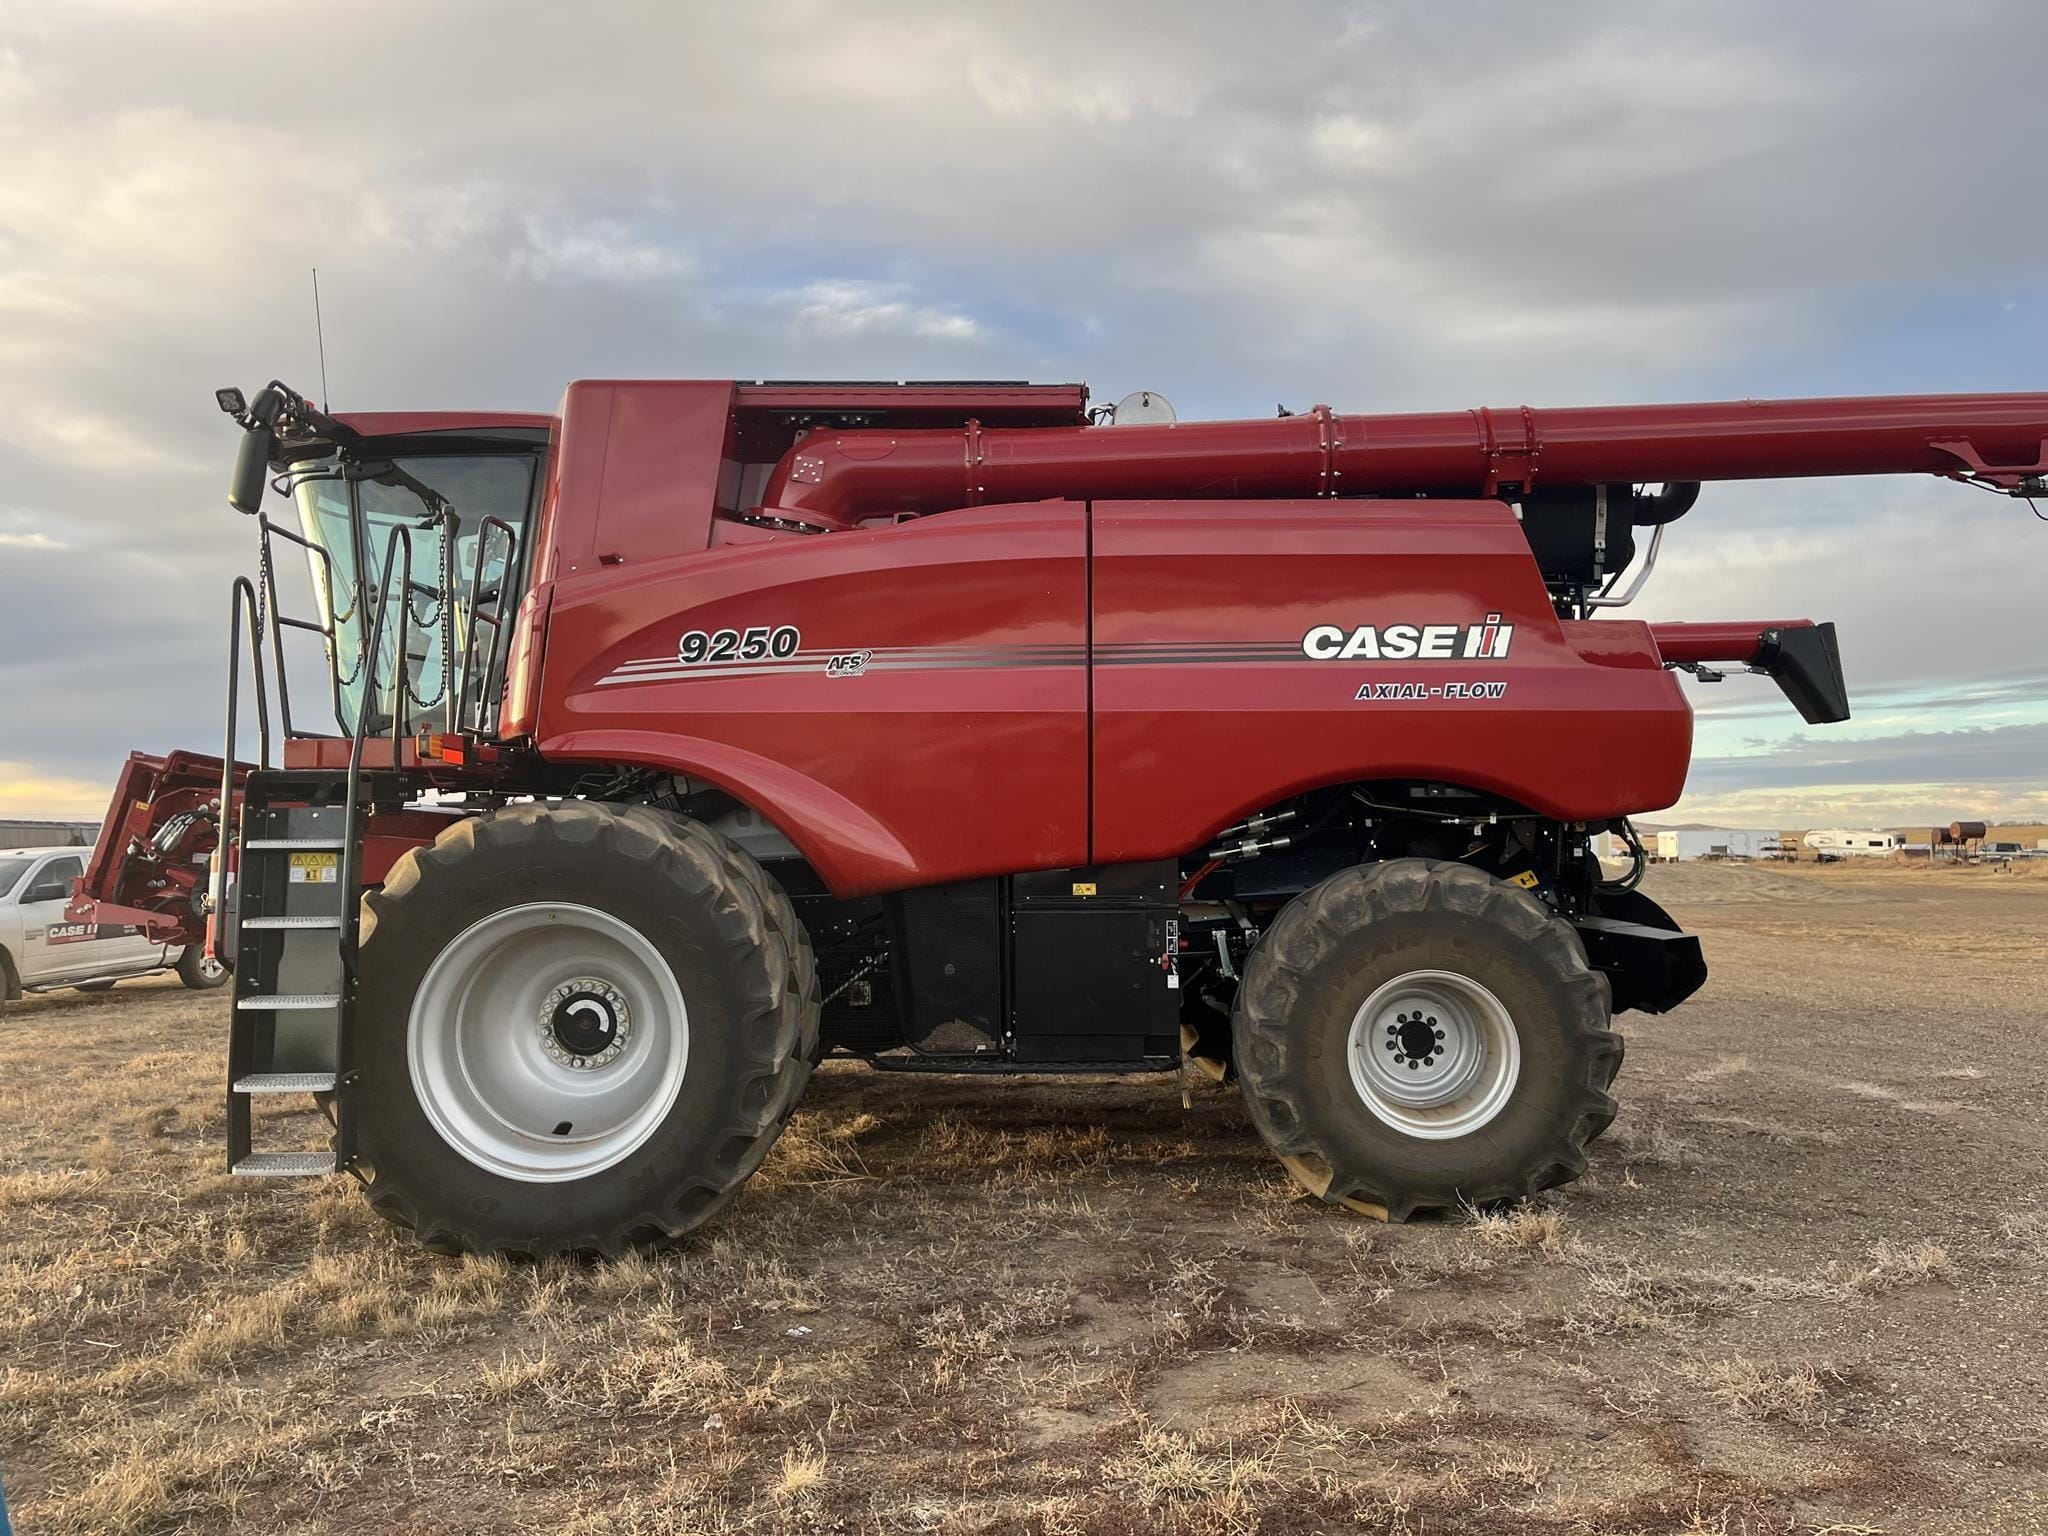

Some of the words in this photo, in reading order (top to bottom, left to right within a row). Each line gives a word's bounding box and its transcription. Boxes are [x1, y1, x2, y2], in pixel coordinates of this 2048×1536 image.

[679, 625, 800, 664] 9250
[1303, 624, 1458, 659] CASE
[827, 655, 863, 670] AFS
[1355, 682, 1507, 700] AXIAL-FLOW
[48, 926, 85, 938] CASE
